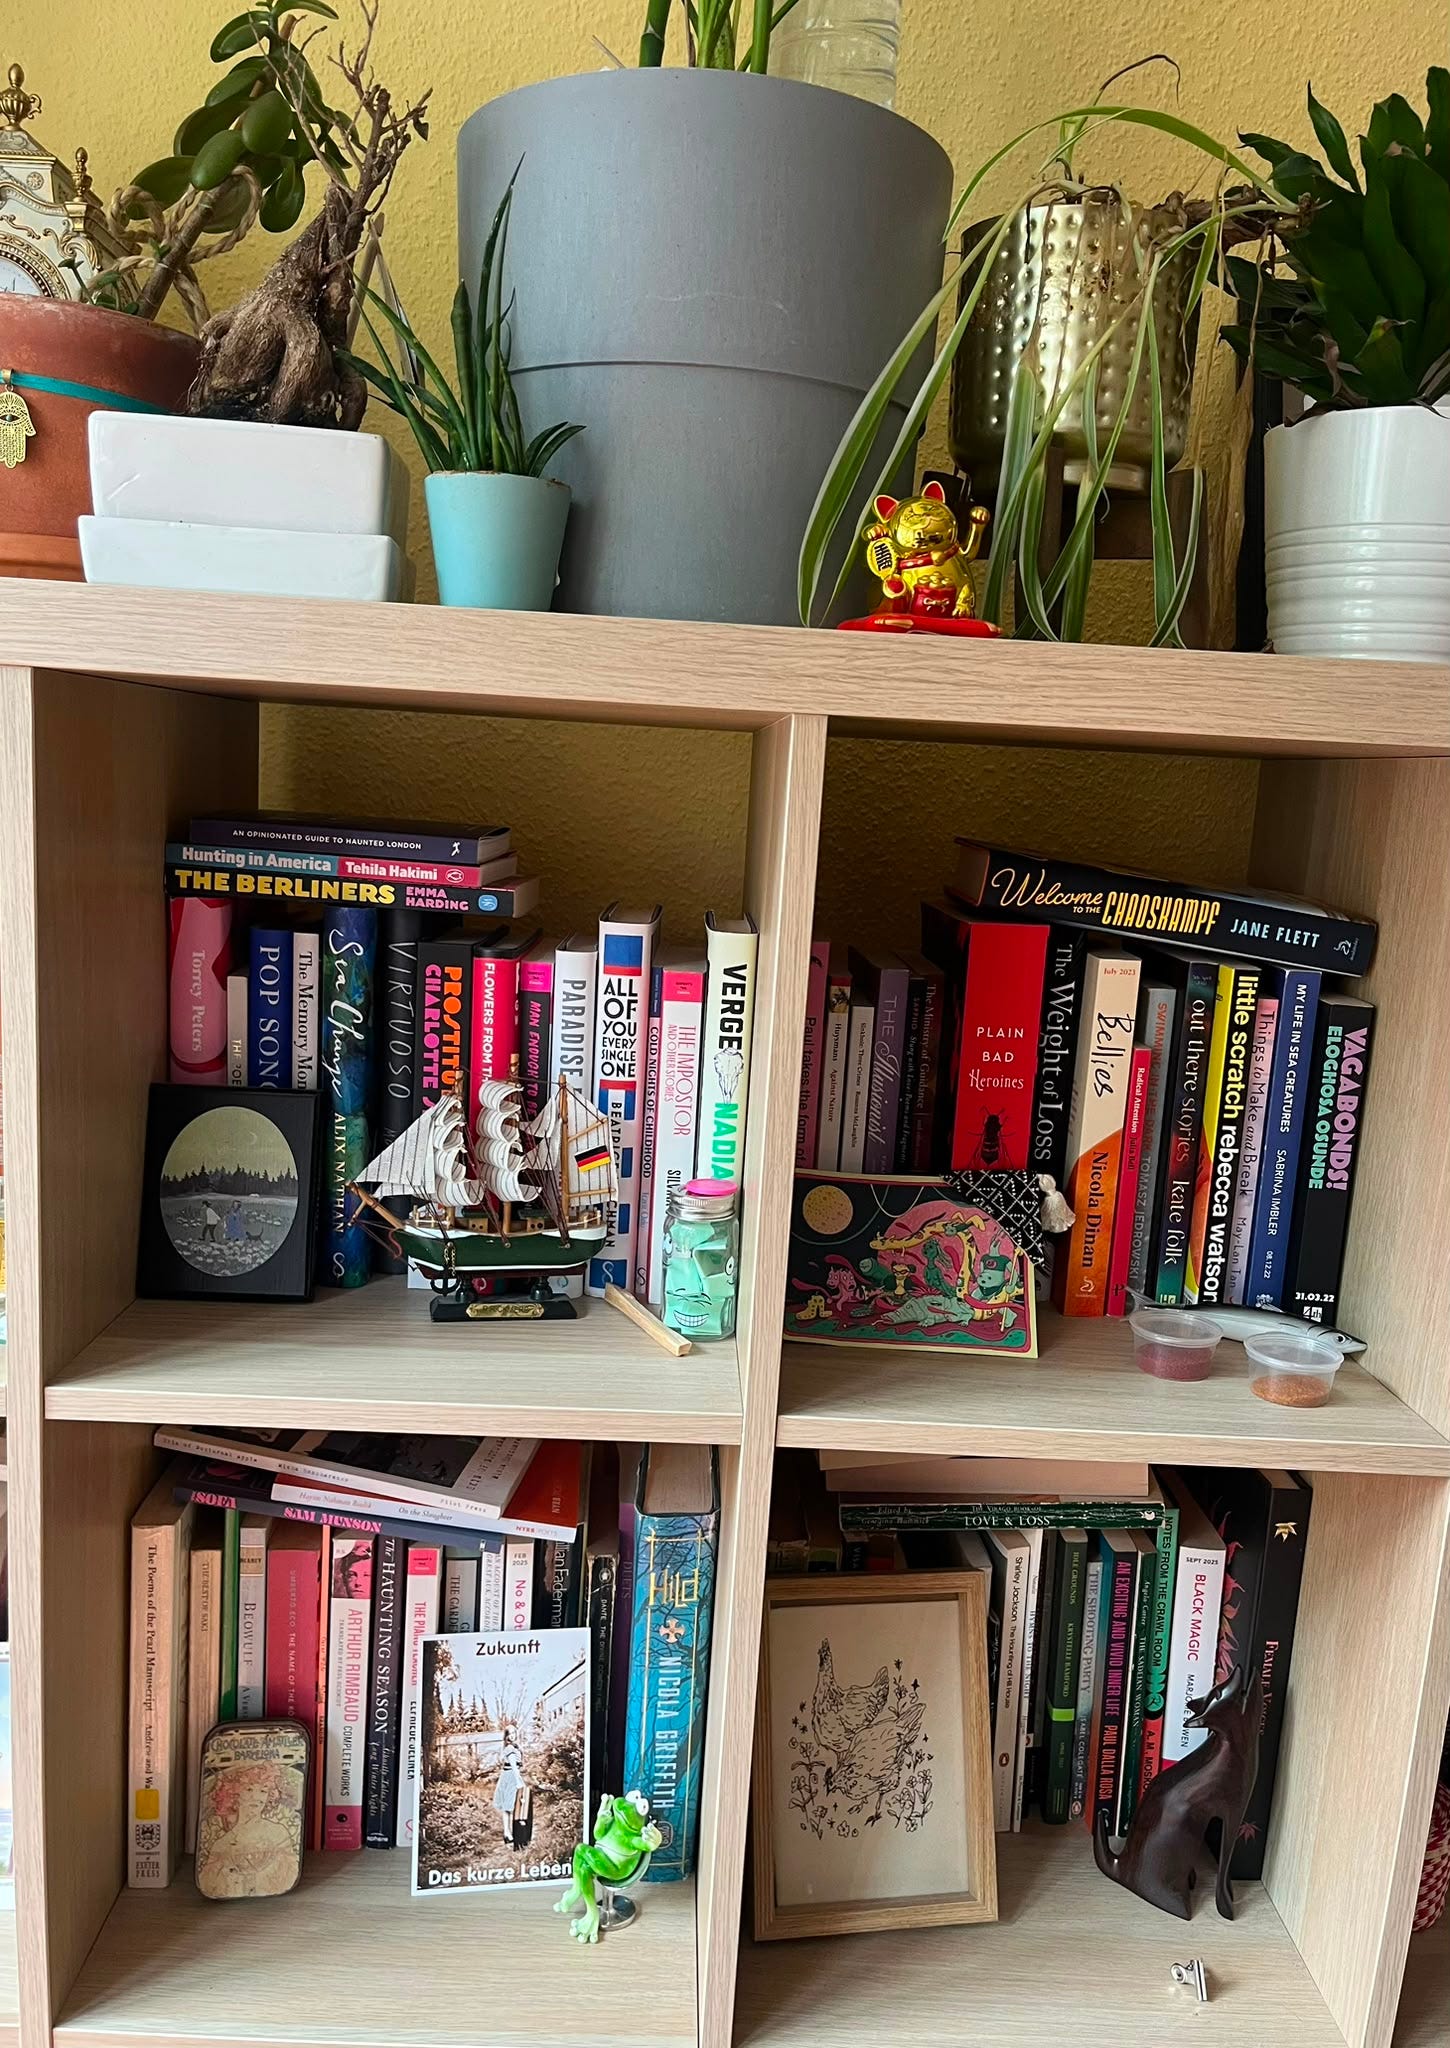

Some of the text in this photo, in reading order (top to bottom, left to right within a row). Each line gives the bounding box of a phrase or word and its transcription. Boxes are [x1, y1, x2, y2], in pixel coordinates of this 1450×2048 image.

[182, 847, 332, 872] Hunting in America
[246, 830, 422, 850] OPINIONATED GUIDE HAUNTED LONDON
[174, 869, 396, 905] THE BERLINERS
[345, 861, 438, 881] Tehila Hakimi
[406, 886, 447, 899] EMMA
[405, 897, 469, 911] HARDING
[991, 868, 1221, 936] Welcome CHAOSKAMPF
[1085, 906, 1101, 914] THE
[1230, 918, 1320, 949] JANE FLETT
[259, 945, 281, 1007] POP
[603, 977, 639, 998] ALL
[1103, 967, 1136, 976] July 2023
[294, 951, 314, 1049] The Memory
[322, 928, 365, 1098] Sea Change
[387, 941, 418, 1100] VIRTUOSO
[482, 962, 496, 1063] FLOWERS FROM
[603, 997, 639, 1020] OF
[719, 964, 748, 1050] VERGE
[1038, 944, 1076, 1077] The Weight
[1189, 999, 1206, 1033] out
[191, 1005, 206, 1053] Peters
[422, 963, 442, 1089] CHARLOTTE
[560, 979, 587, 1078] PARADISE
[602, 1020, 638, 1037] YOU
[602, 1037, 637, 1049] EVERY
[650, 1026, 659, 1056] COLD
[977, 1027, 1024, 1038] PLAIN
[601, 1050, 636, 1062] SINGLE
[601, 1062, 636, 1078] ONE
[648, 1058, 658, 1097] NIGHTS
[664, 1041, 677, 1102] OTHER STORIES
[868, 995, 901, 1146] THE Illusionist
[983, 1051, 1014, 1062] BAD
[1091, 1012, 1135, 1098] Bellies
[1183, 1039, 1205, 1092] there
[527, 1082, 538, 1097] TO
[674, 1026, 696, 1136] THE IMPOSTOR
[916, 1062, 930, 1109] Guidance
[969, 1069, 1024, 1090] Heroines
[1131, 1067, 1145, 1133] Radical Attention
[647, 1100, 656, 1113] OF
[1267, 984, 1308, 1236] MY LIFE IN SEA CREATURES SABRINA IMBLER
[1309, 1026, 1344, 1190] ELOGHOSA OSUNDE
[1326, 1028, 1368, 1191] VAGABONDS!
[642, 1116, 655, 1178] CHILDHOOD
[1203, 976, 1260, 1303] little scratch rebecca watson
[1231, 1011, 1275, 1265] Things Make and Break May-Lan
[333, 1112, 347, 1233] ALIX NATHAN
[1082, 1151, 1109, 1268] Nicola Dinan
[1129, 1156, 1152, 1279] TOMASZ JEDROWSKI
[1168, 1180, 1190, 1223] kate
[1164, 1229, 1186, 1265] folk
[1295, 1291, 1335, 1303] 31.03.22
[283, 1507, 382, 1533] SAM MUNSON
[422, 1509, 453, 1521] Slaughter
[964, 1515, 1051, 1527] LOVE & LOSS
[1186, 1556, 1202, 1564] SEPT
[414, 1602, 426, 1618] THE
[514, 1580, 526, 1610] No &
[648, 1569, 700, 1609] Hild
[1069, 1570, 1079, 1605] GROUNDS
[1152, 1516, 1174, 1667] NOTES FROM THE CRAWL ROOM
[242, 1602, 257, 1667] BEOWULF
[374, 1538, 397, 1734] The HAUNTING SEASON
[1006, 1557, 1024, 1668] Shirley Jackson Haunting
[1080, 1571, 1100, 1693] THE SHOOTING PARTY
[1187, 1573, 1207, 1661] BLACK MAGIC
[143, 1544, 158, 1757] The Poems Pearl Manuscript Andrew
[476, 1639, 541, 1657] Zukunft
[1260, 1640, 1279, 1689] FEMALE
[340, 1609, 363, 1797] ARTHUR RIMBAUD COMPLETE WORKS
[1098, 1561, 1132, 1800] AN EXCITING AND VIVID INNER LIFE PAUL DALLA ROSA
[652, 1655, 682, 1810] NICOLA GRIFFITH
[136, 1870, 160, 1878] PRESS
[428, 1861, 572, 1885] Das kurze Leben
